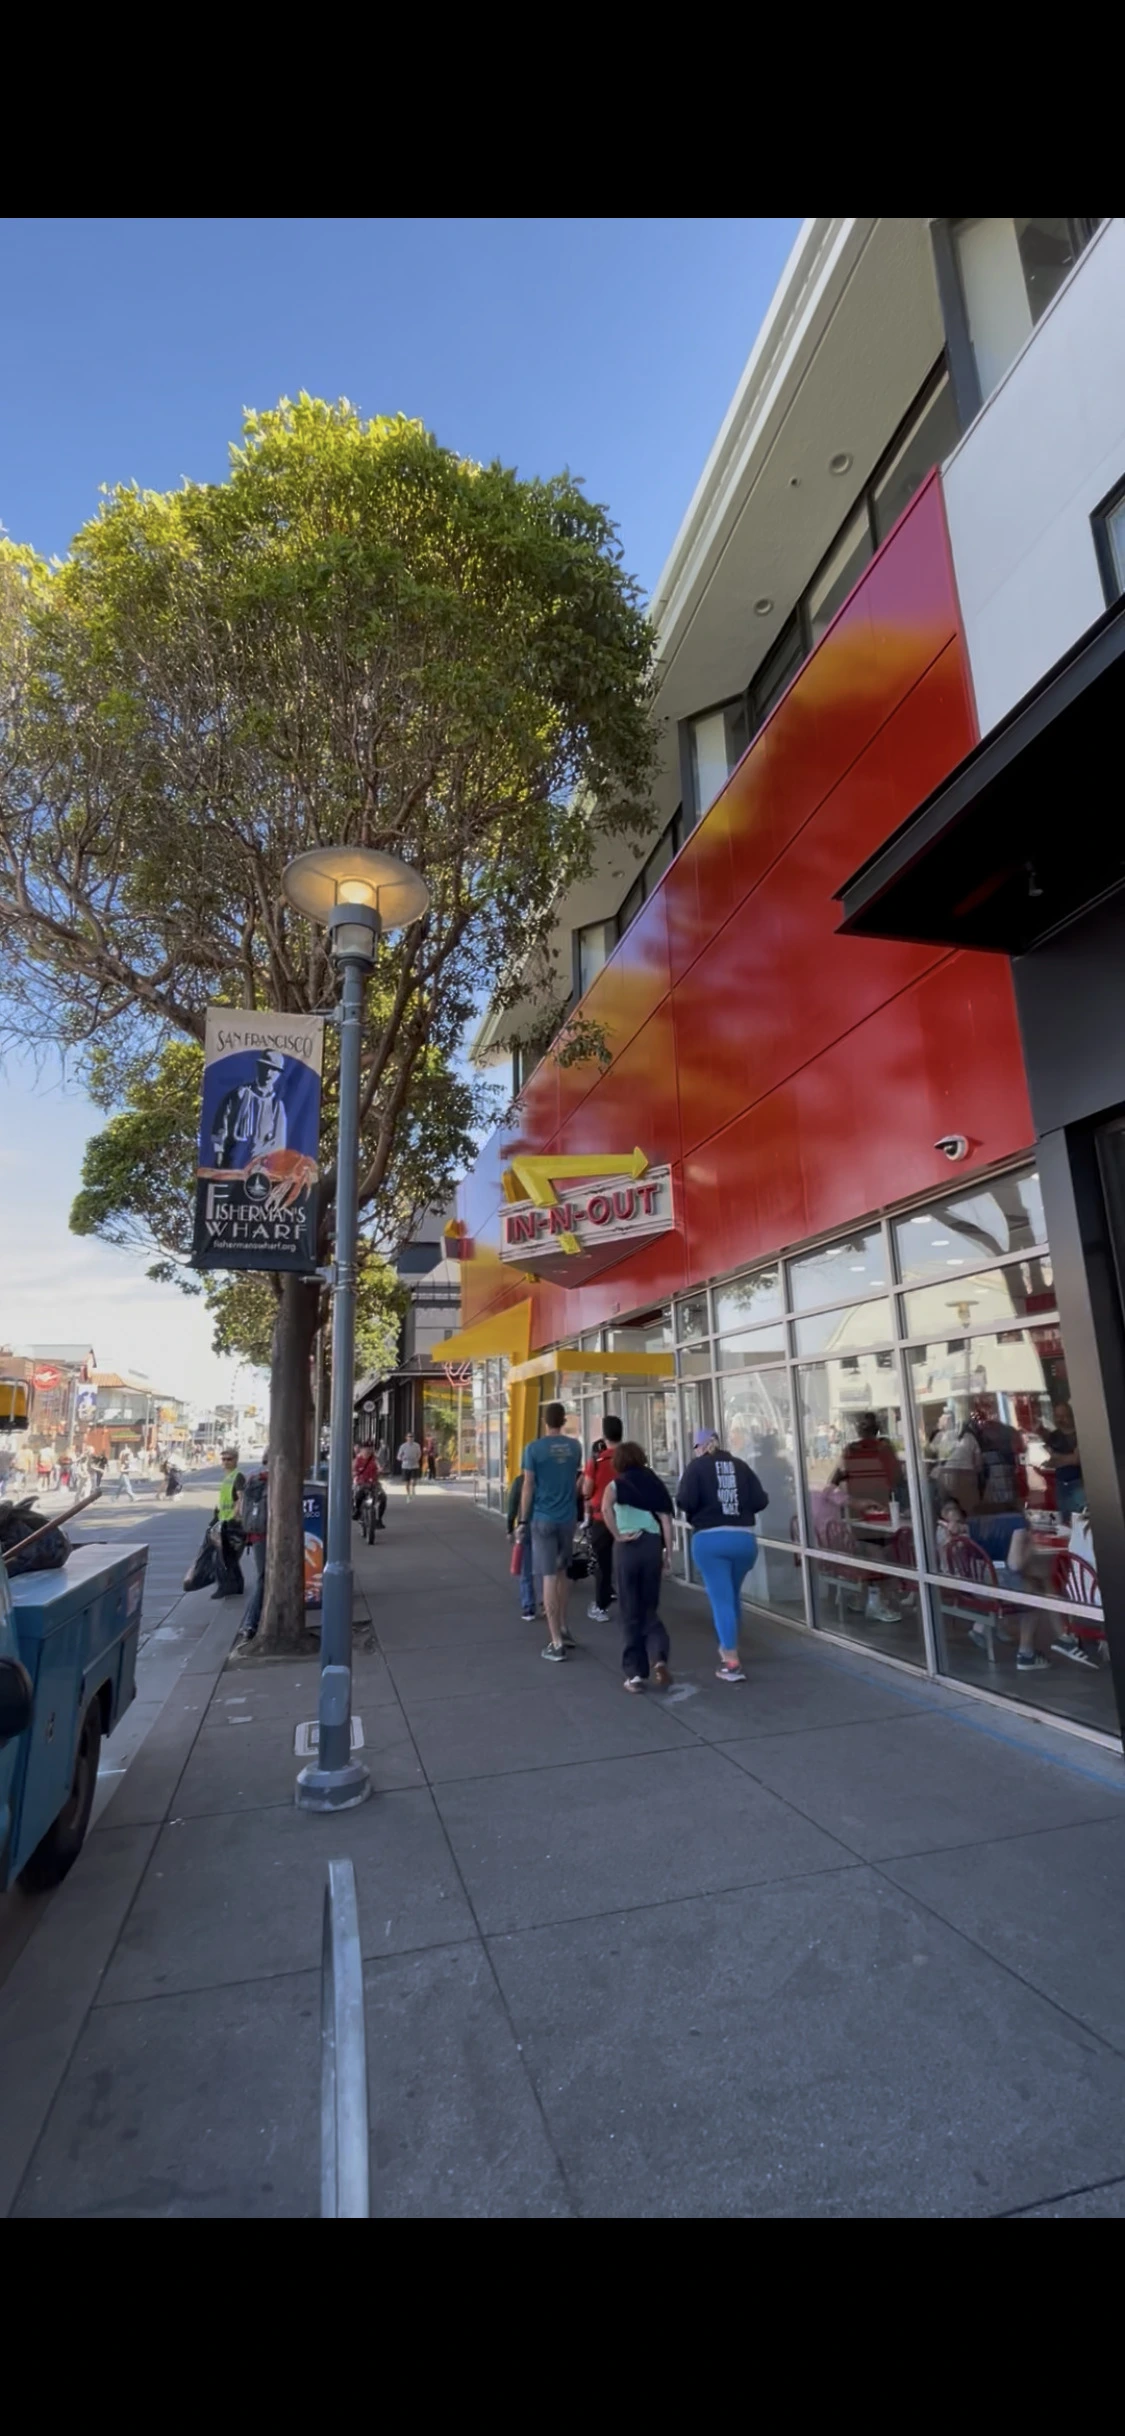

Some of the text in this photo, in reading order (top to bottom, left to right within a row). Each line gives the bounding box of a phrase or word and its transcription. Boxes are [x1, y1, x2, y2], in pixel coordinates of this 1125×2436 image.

[217, 1030, 313, 1058] SAN FRANCISCO
[205, 1184, 306, 1223] FISHERMAN'S
[506, 1182, 661, 1244] IN-N-OUT
[205, 1222, 307, 1240] WHARF
[213, 1240, 296, 1253] fishermanswharf.org
[715, 1461, 735, 1474] FIND
[717, 1475, 737, 1489] YOUR
[717, 1488, 738, 1503] MOVE
